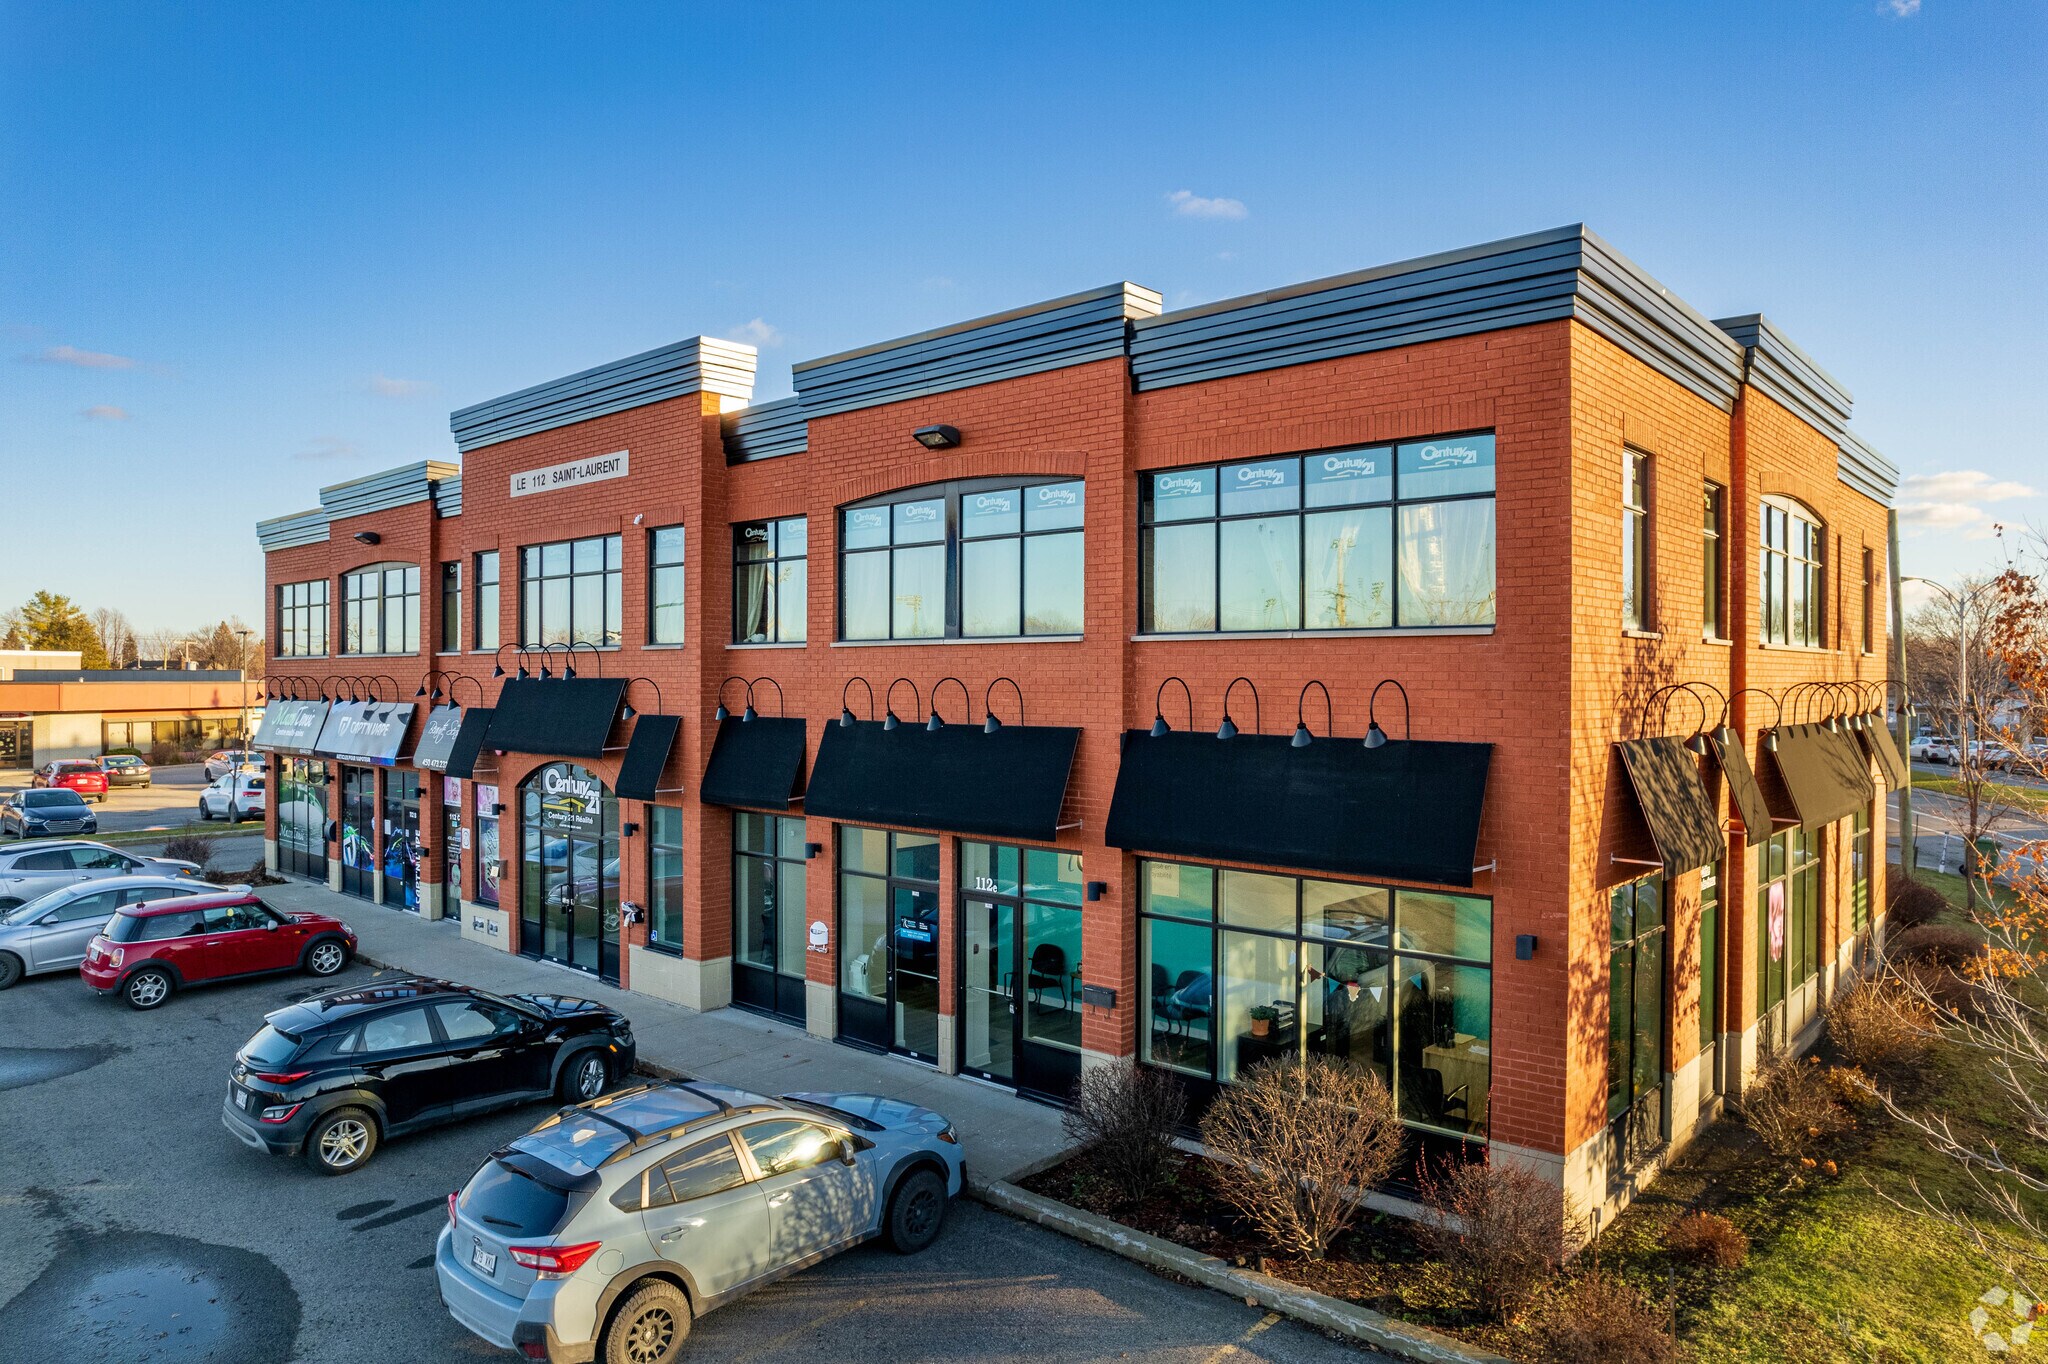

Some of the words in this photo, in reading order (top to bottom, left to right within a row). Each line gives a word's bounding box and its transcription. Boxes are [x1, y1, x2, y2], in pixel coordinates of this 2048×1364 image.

[1420, 446, 1467, 461] Century
[1462, 450, 1476, 464] 21
[1324, 457, 1366, 472] Century
[1362, 462, 1374, 474] 21
[516, 478, 526, 490] LE
[532, 474, 546, 487] 112
[552, 458, 620, 484] SAINT-LAURENT
[1238, 468, 1276, 481] Century
[1272, 472, 1284, 484] 21
[1160, 477, 1194, 490] Century
[1190, 482, 1202, 494] 21
[1002, 500, 1010, 512] 21
[1066, 492, 1076, 504] 21
[928, 510, 936, 520] 21
[545, 768, 590, 798] Century
[586, 790, 600, 814] 21
[548, 812, 567, 822] Century
